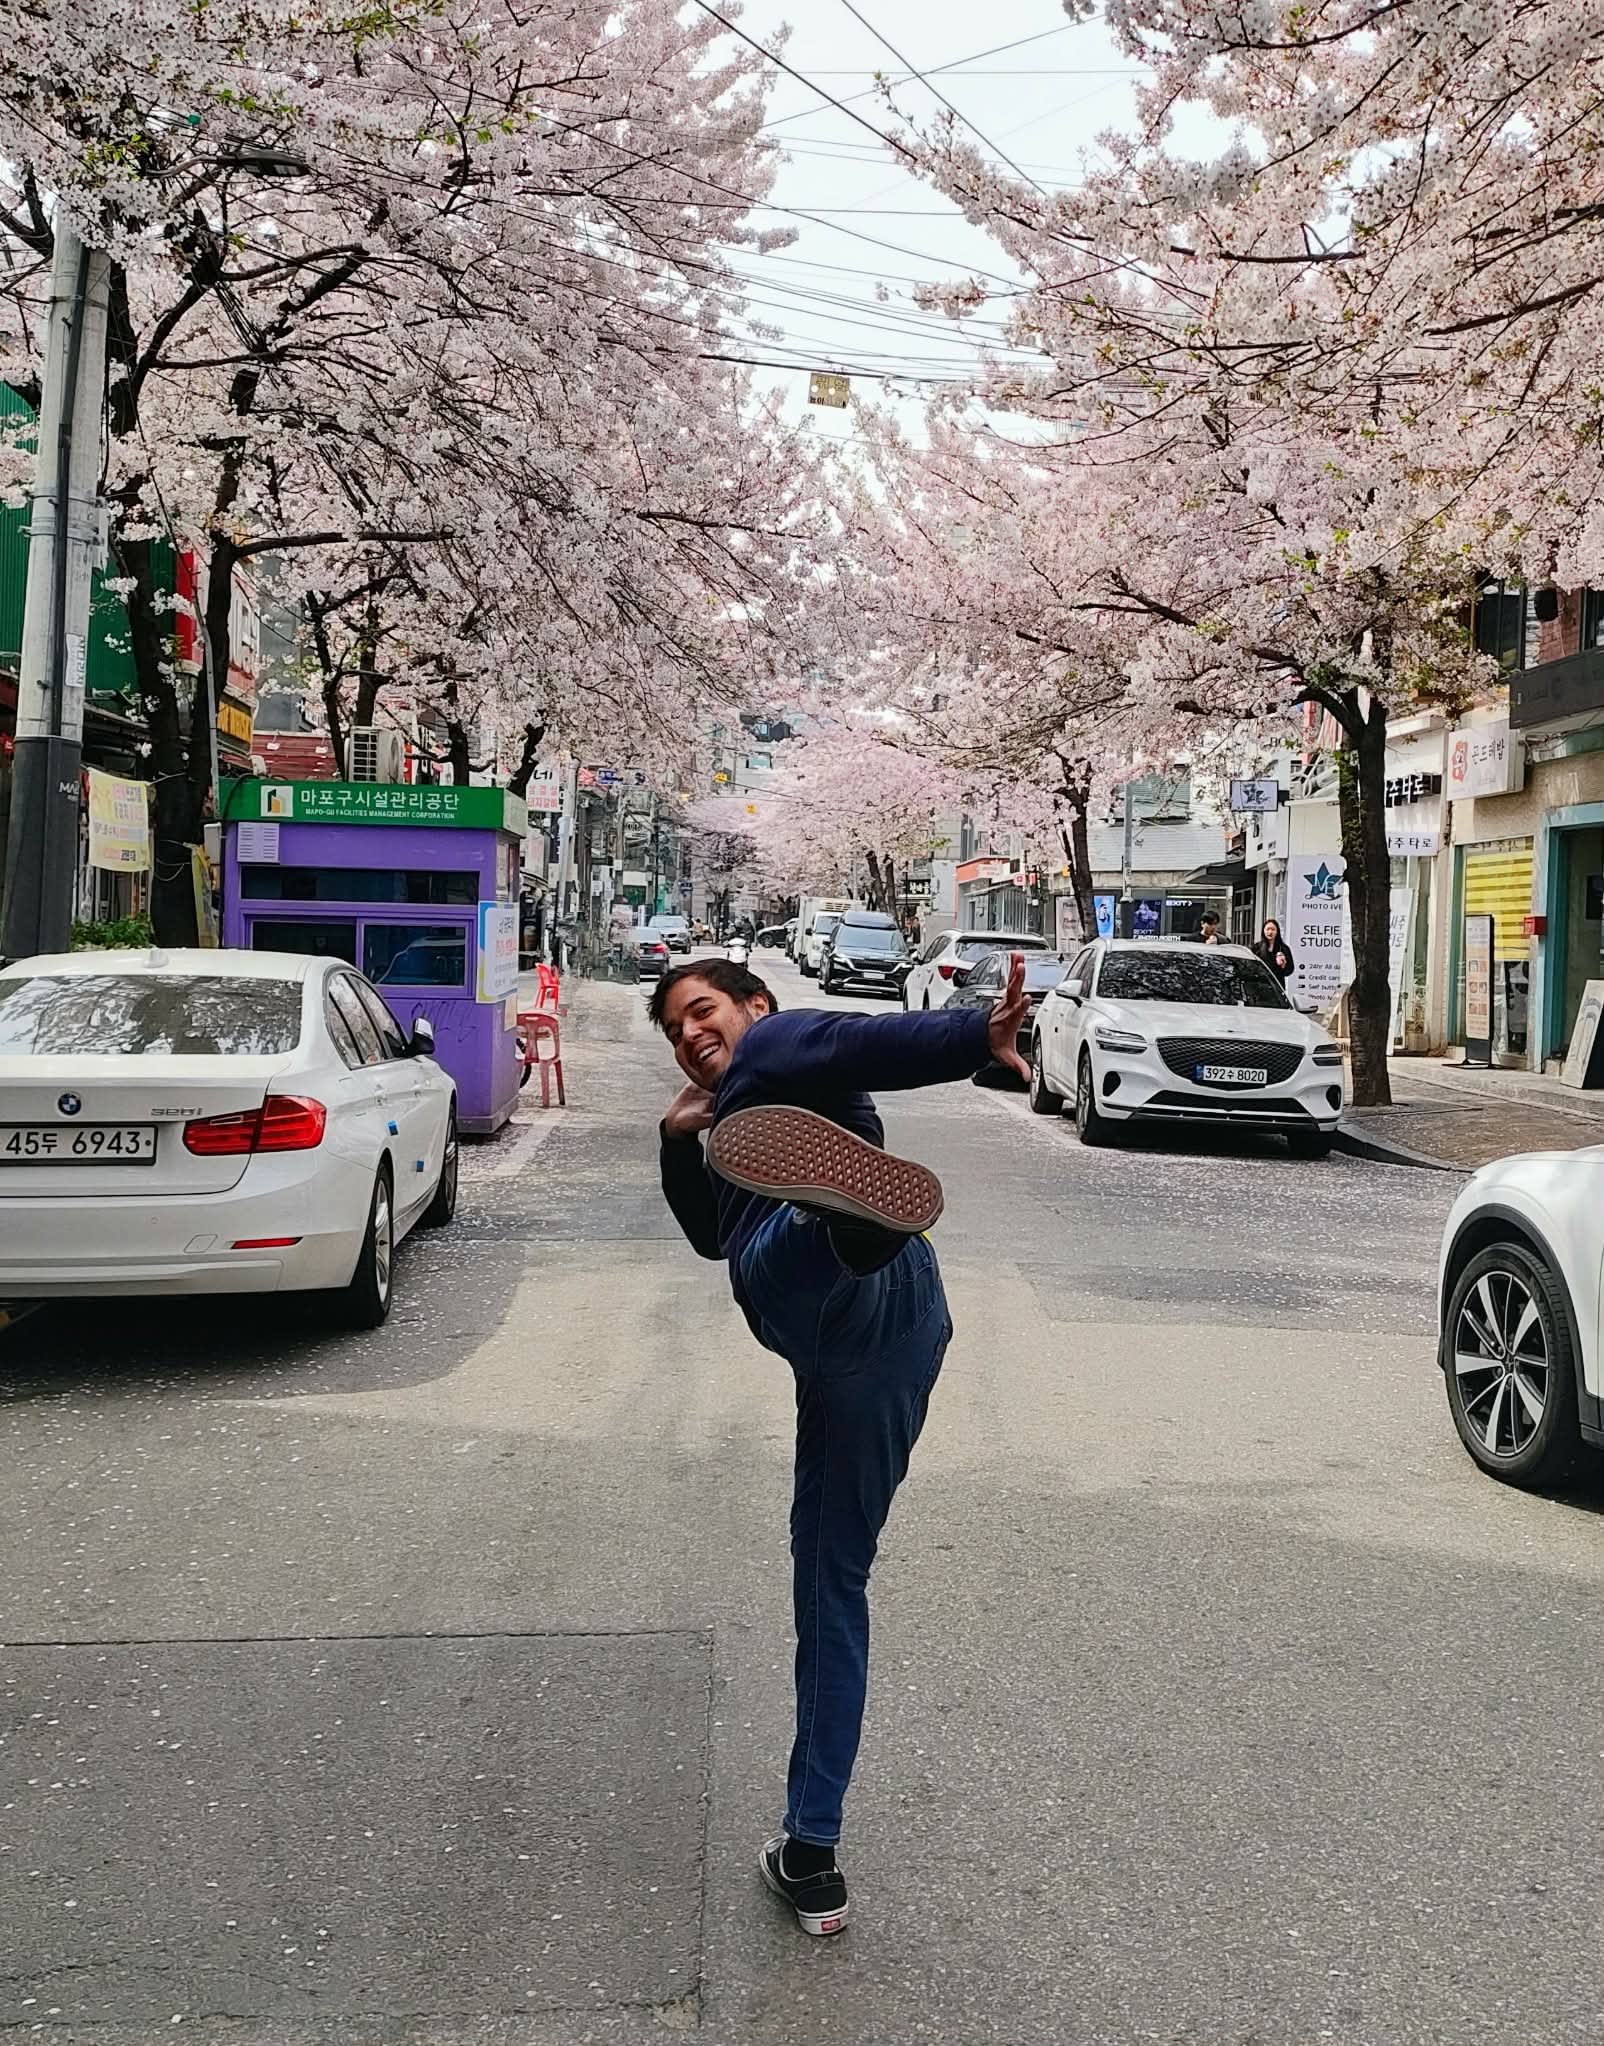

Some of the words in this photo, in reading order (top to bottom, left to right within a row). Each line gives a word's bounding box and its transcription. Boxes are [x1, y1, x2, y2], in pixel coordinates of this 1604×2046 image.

[301, 788, 460, 811] 마포구시설관리공단
[1302, 903, 1329, 911] PHOTO
[1303, 925, 1341, 936] SELFIE
[1300, 938, 1343, 948] STUDIO
[1205, 1067, 1234, 1081] 392수
[1237, 1069, 1265, 1082] 8020
[6, 1131, 58, 1155] 45두
[72, 1131, 141, 1155] 6943
